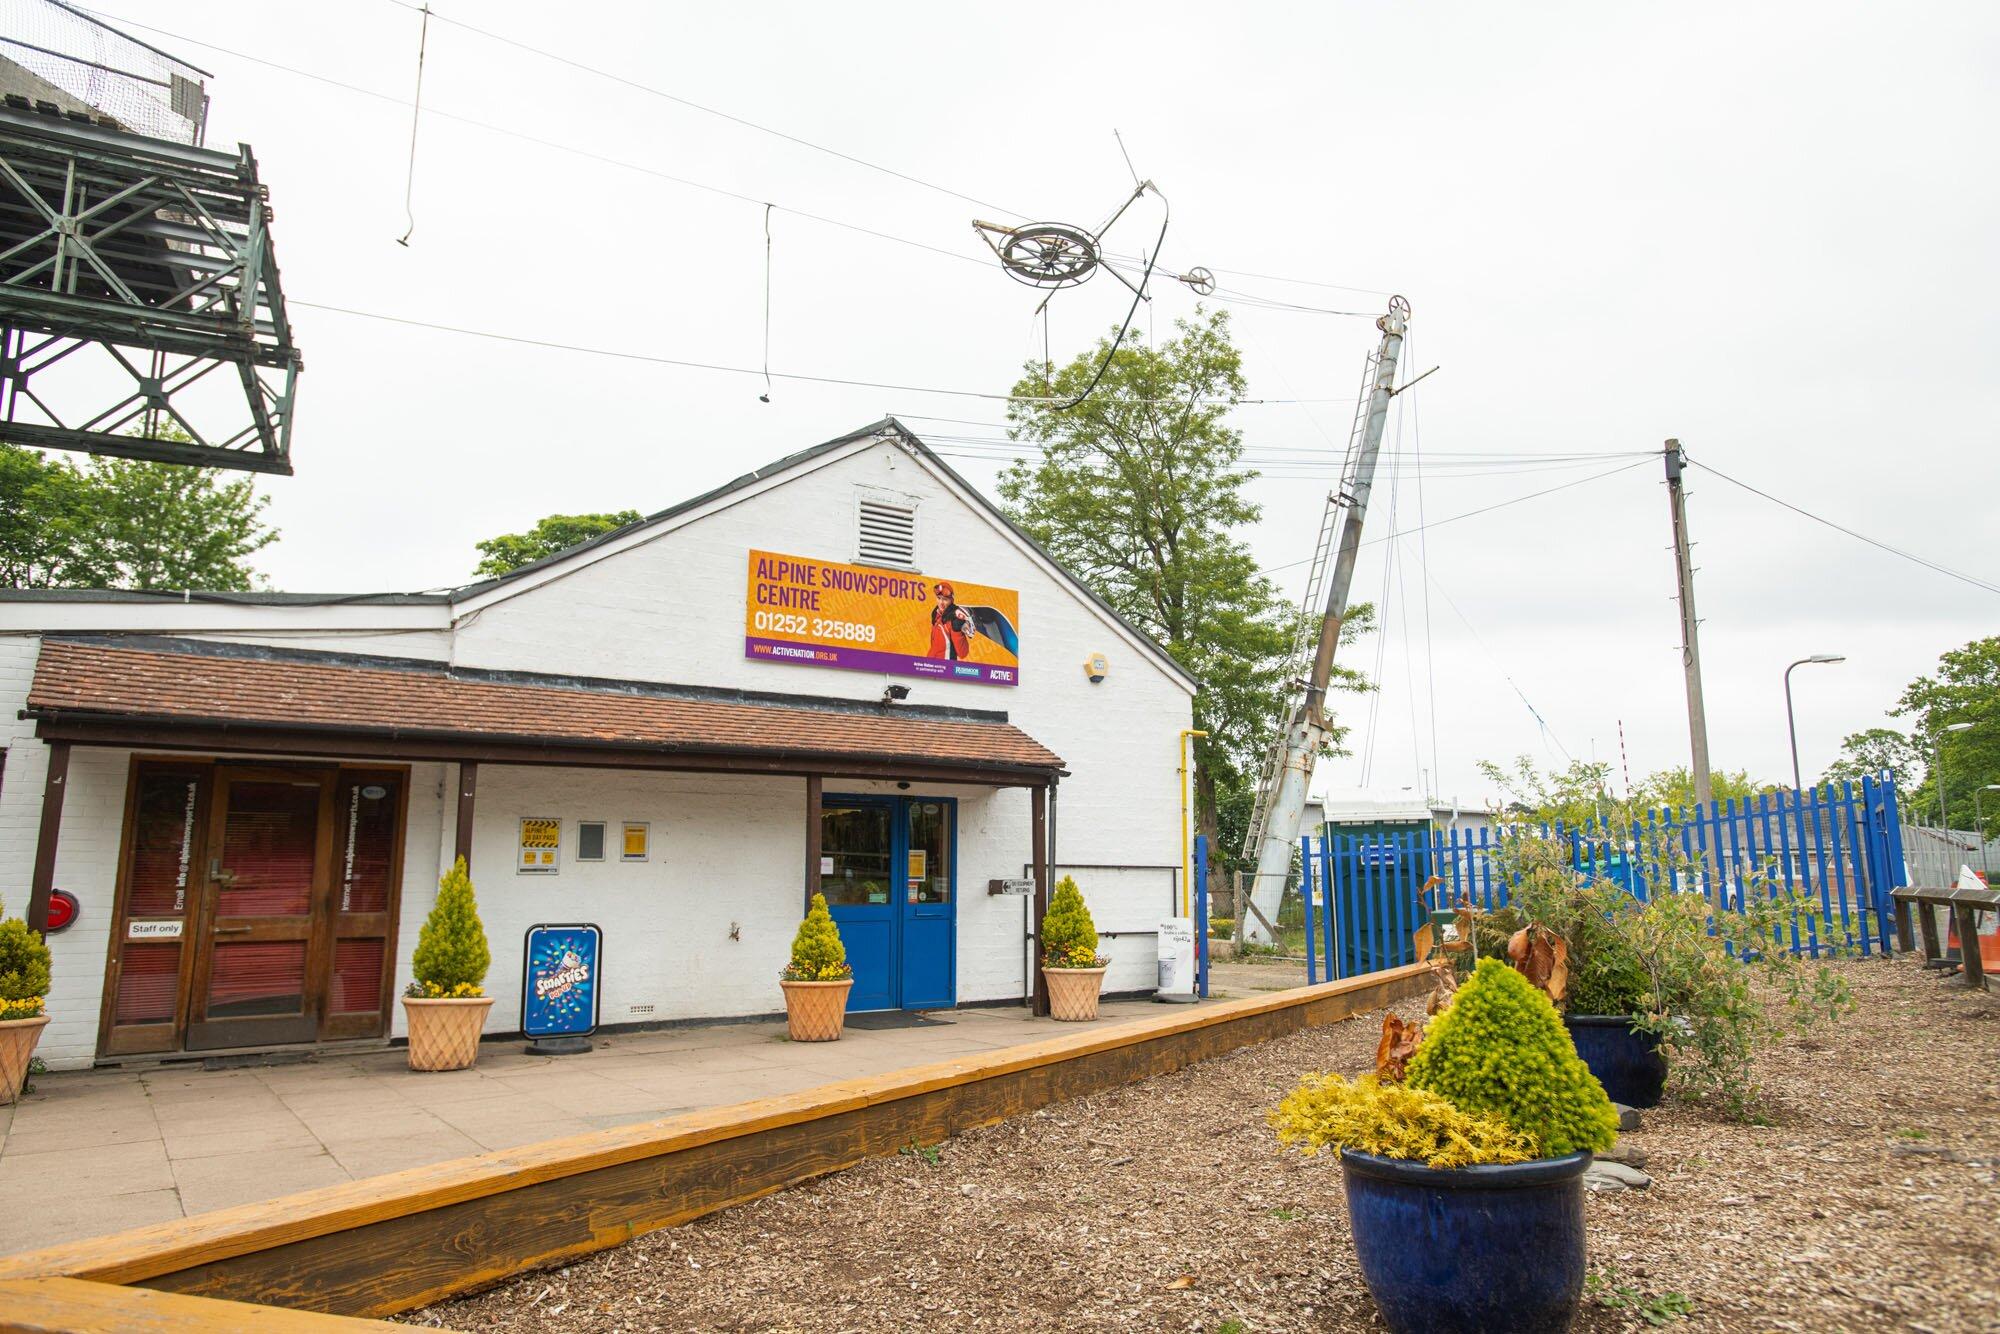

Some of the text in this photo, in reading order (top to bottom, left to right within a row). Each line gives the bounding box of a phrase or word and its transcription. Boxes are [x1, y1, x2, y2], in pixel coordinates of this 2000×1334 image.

[757, 558, 817, 586] ALPINE
[821, 567, 927, 601] SNOWSPORTS
[757, 583, 821, 611] CENTRE
[754, 611, 808, 635] 01252
[812, 618, 876, 643] 325889
[753, 644, 838, 662] WWW.ACTIVENATION.ORG.UK
[174, 889, 185, 911] Email
[341, 883, 352, 912] Internet
[132, 924, 180, 934] Staff only
[536, 965, 588, 995] SMARTIES
